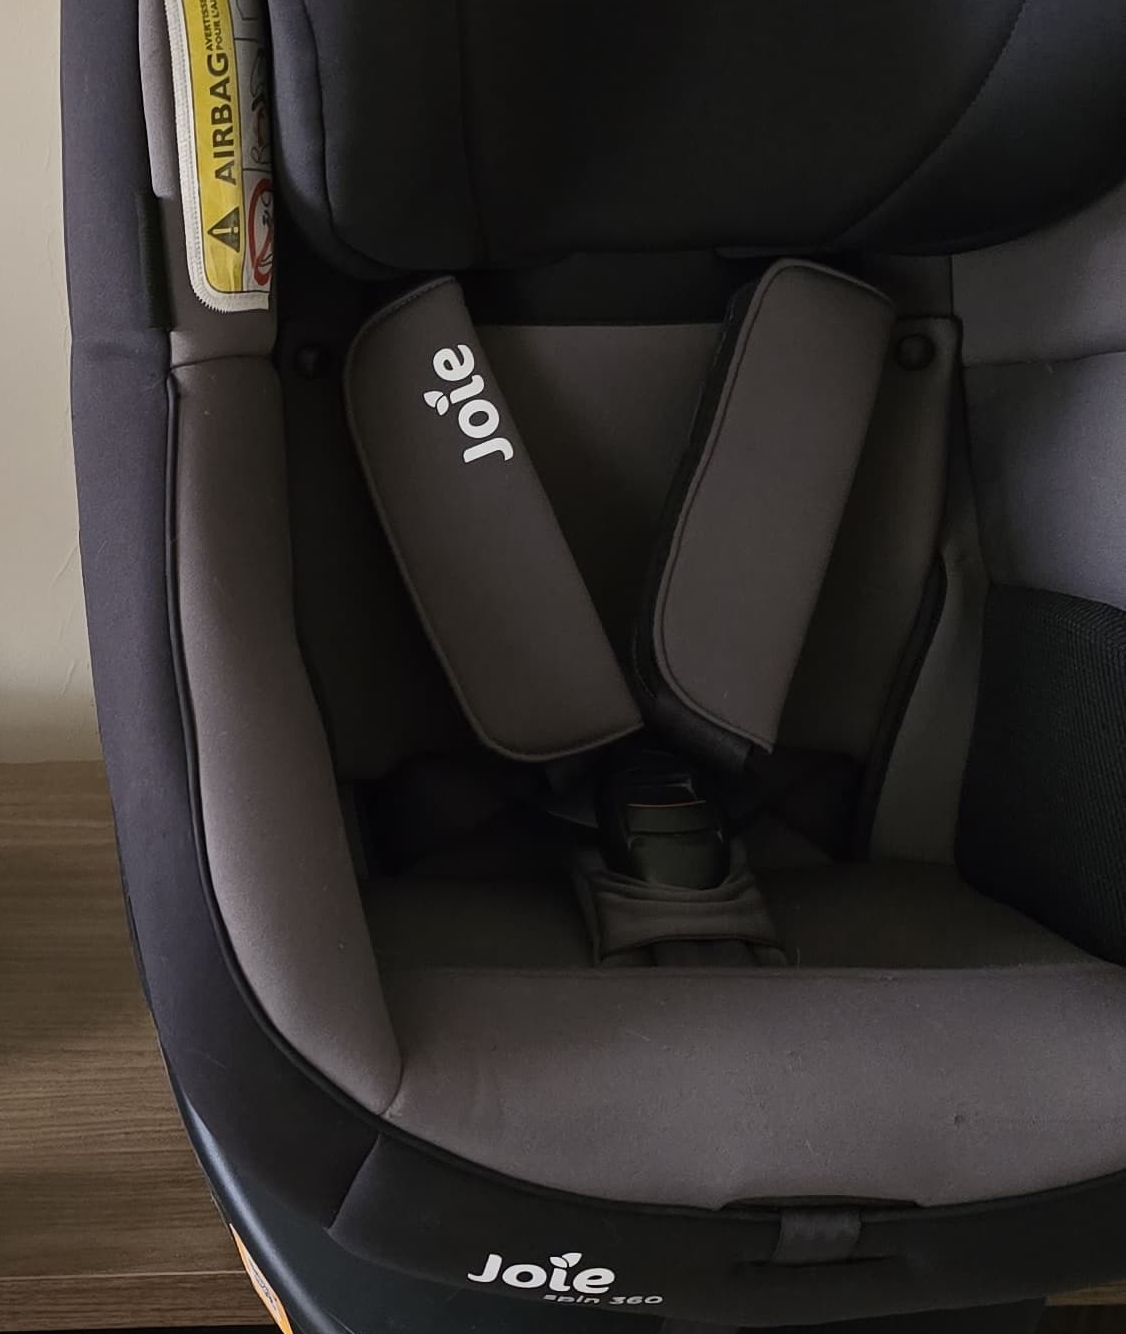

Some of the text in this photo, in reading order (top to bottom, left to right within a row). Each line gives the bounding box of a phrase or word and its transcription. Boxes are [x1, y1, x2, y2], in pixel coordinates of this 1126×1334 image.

[213, 21, 223, 50] POUR
[207, 53, 236, 185] AIRBAG
[424, 344, 514, 463] Joie
[467, 1253, 615, 1294] Joie
[543, 1294, 664, 1305] spin 360
